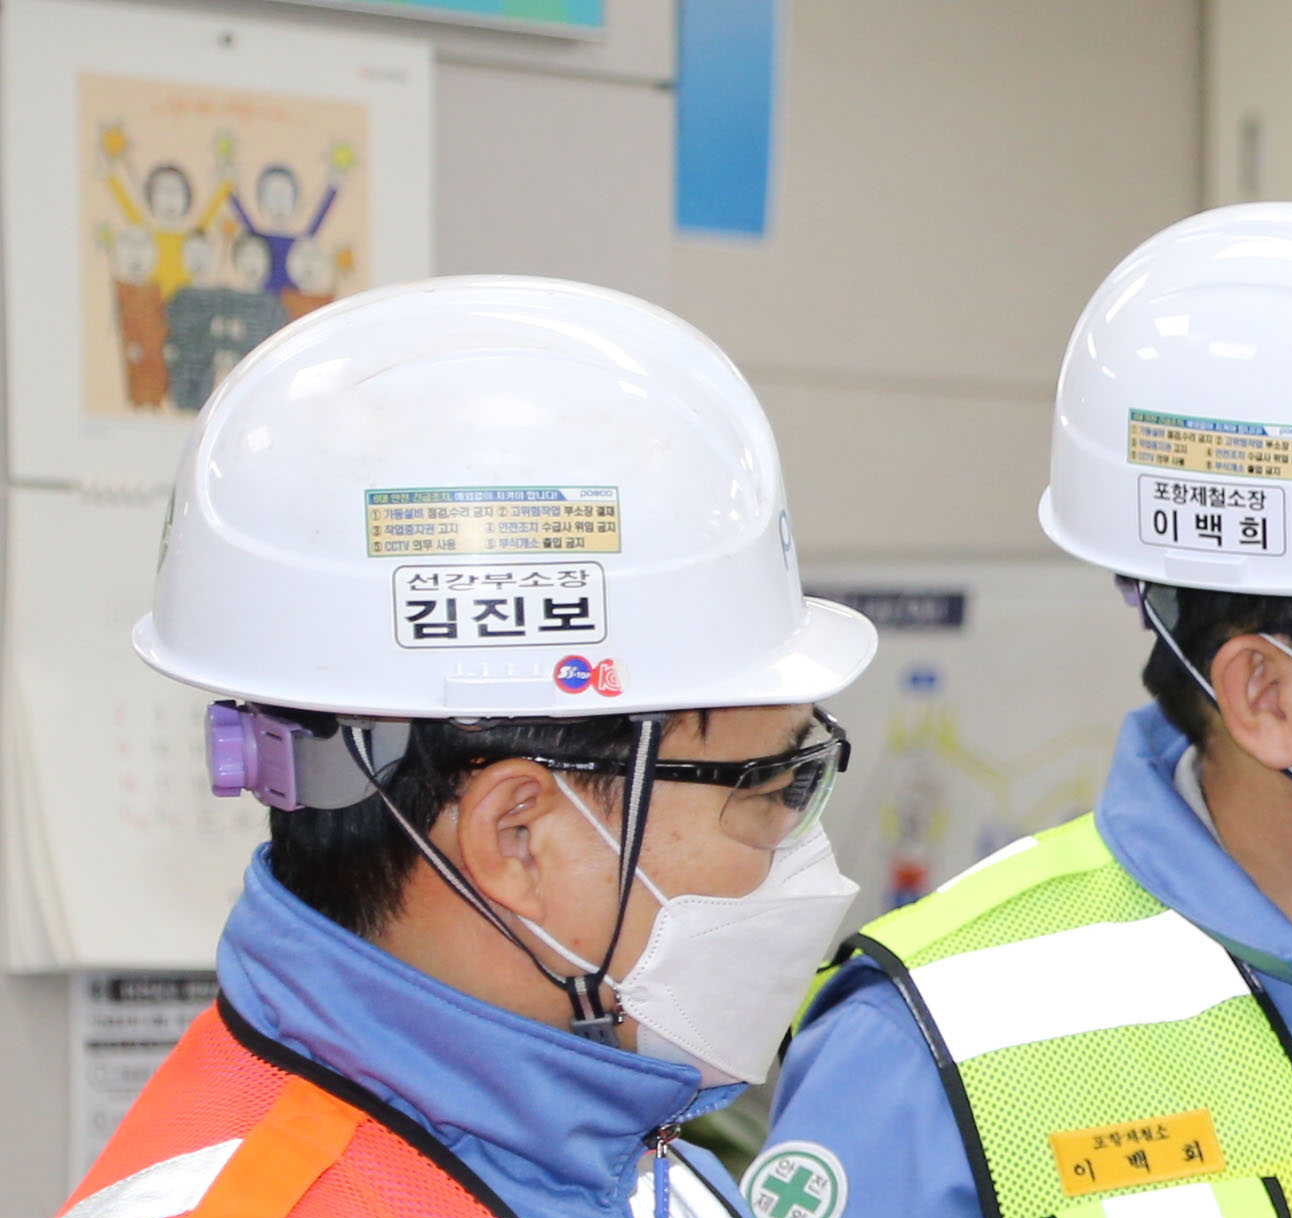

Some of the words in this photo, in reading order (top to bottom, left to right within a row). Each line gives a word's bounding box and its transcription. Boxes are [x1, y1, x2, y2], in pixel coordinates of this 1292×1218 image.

[1153, 482, 1266, 511] 포항제철소장
[407, 569, 590, 592] 선강부소장
[405, 596, 596, 640] 김진보
